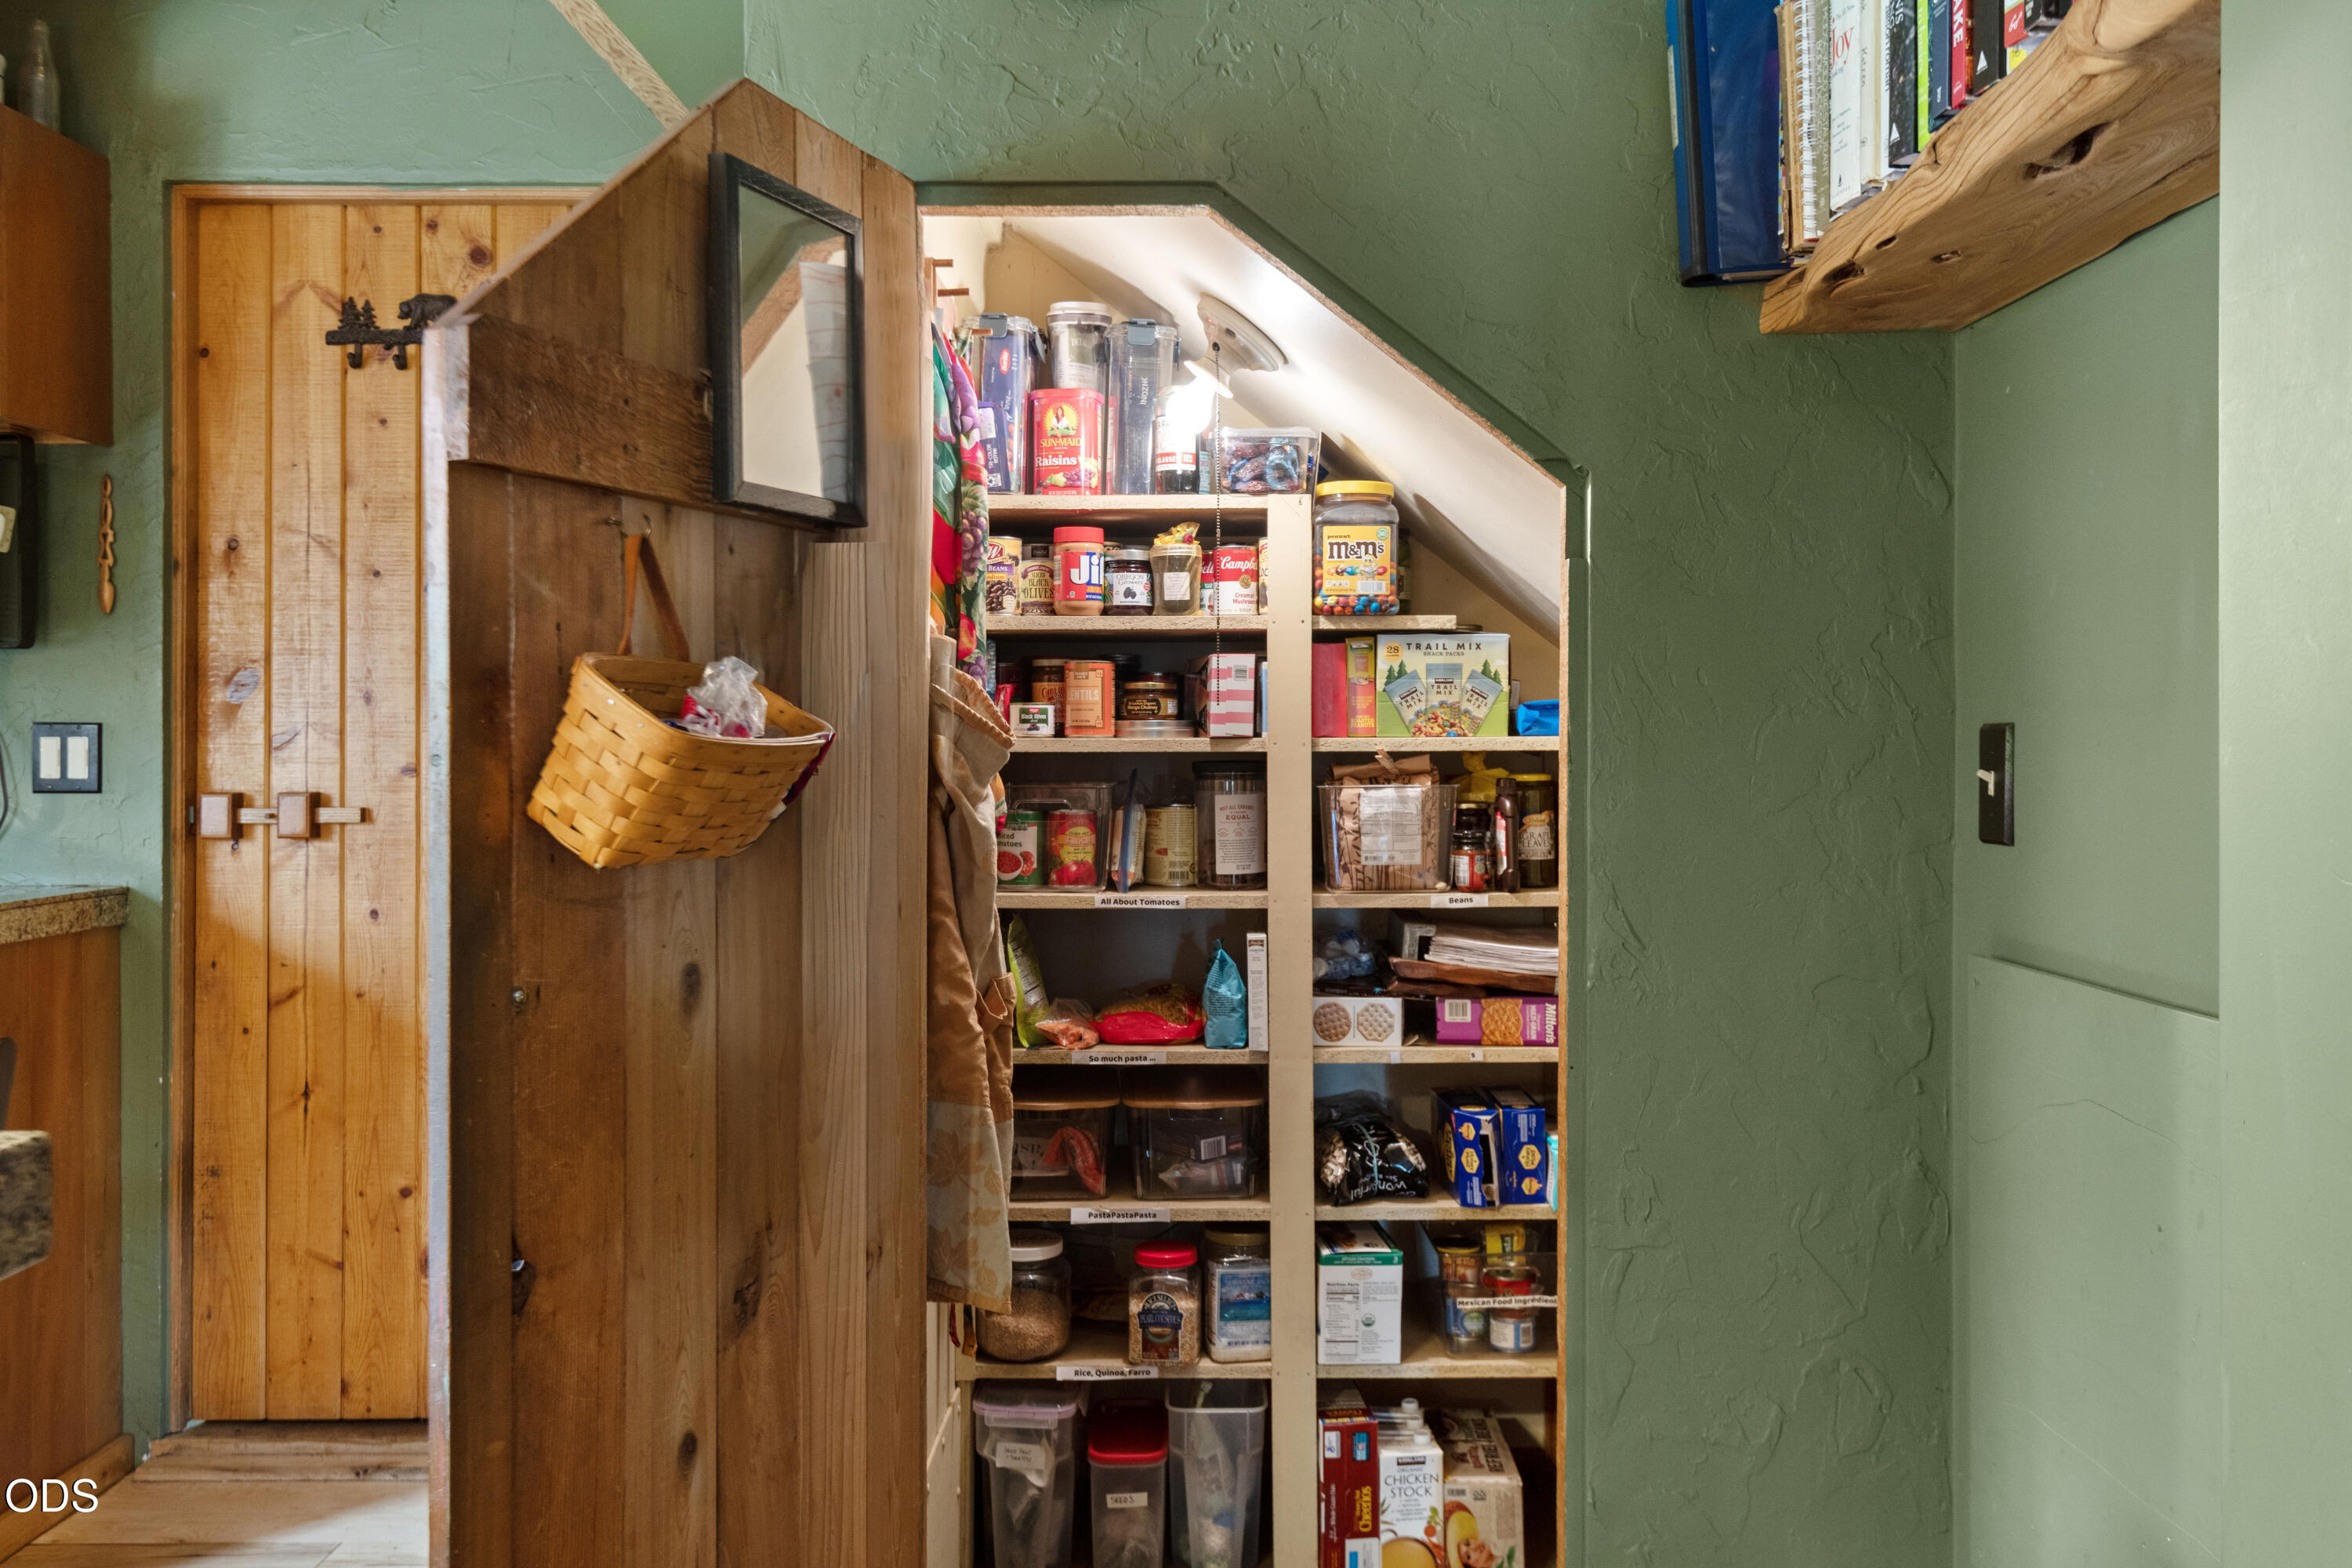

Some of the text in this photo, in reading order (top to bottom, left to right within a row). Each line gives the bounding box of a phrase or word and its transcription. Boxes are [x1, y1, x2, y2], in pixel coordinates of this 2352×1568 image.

[1035, 455, 1078, 466] Raisins
[1029, 578, 1049, 587] BLACK
[1024, 587, 1054, 599] OLIVES
[1386, 645, 1399, 654] 28
[1067, 689, 1099, 702] LENTILS
[1399, 691, 1424, 707] TRAIL
[1464, 689, 1488, 707] TRAIL
[1406, 698, 1423, 710] MIX
[1466, 698, 1482, 710] MIX
[1545, 1003, 1557, 1044] Milton's
[1124, 1055, 1148, 1065] pasta
[1351, 1180, 1407, 1201] wonrful
[1088, 1211, 1157, 1220] PastaPastaPasta
[1458, 1298, 1490, 1307] Mexican
[1492, 1298, 1512, 1306] Food
[1095, 1369, 1127, 1377] Quinoa,
[1385, 1473, 1439, 1487] CHICKEN
[1390, 1486, 1432, 1499] STOCK
[1359, 1486, 1372, 1533] Cheerios
